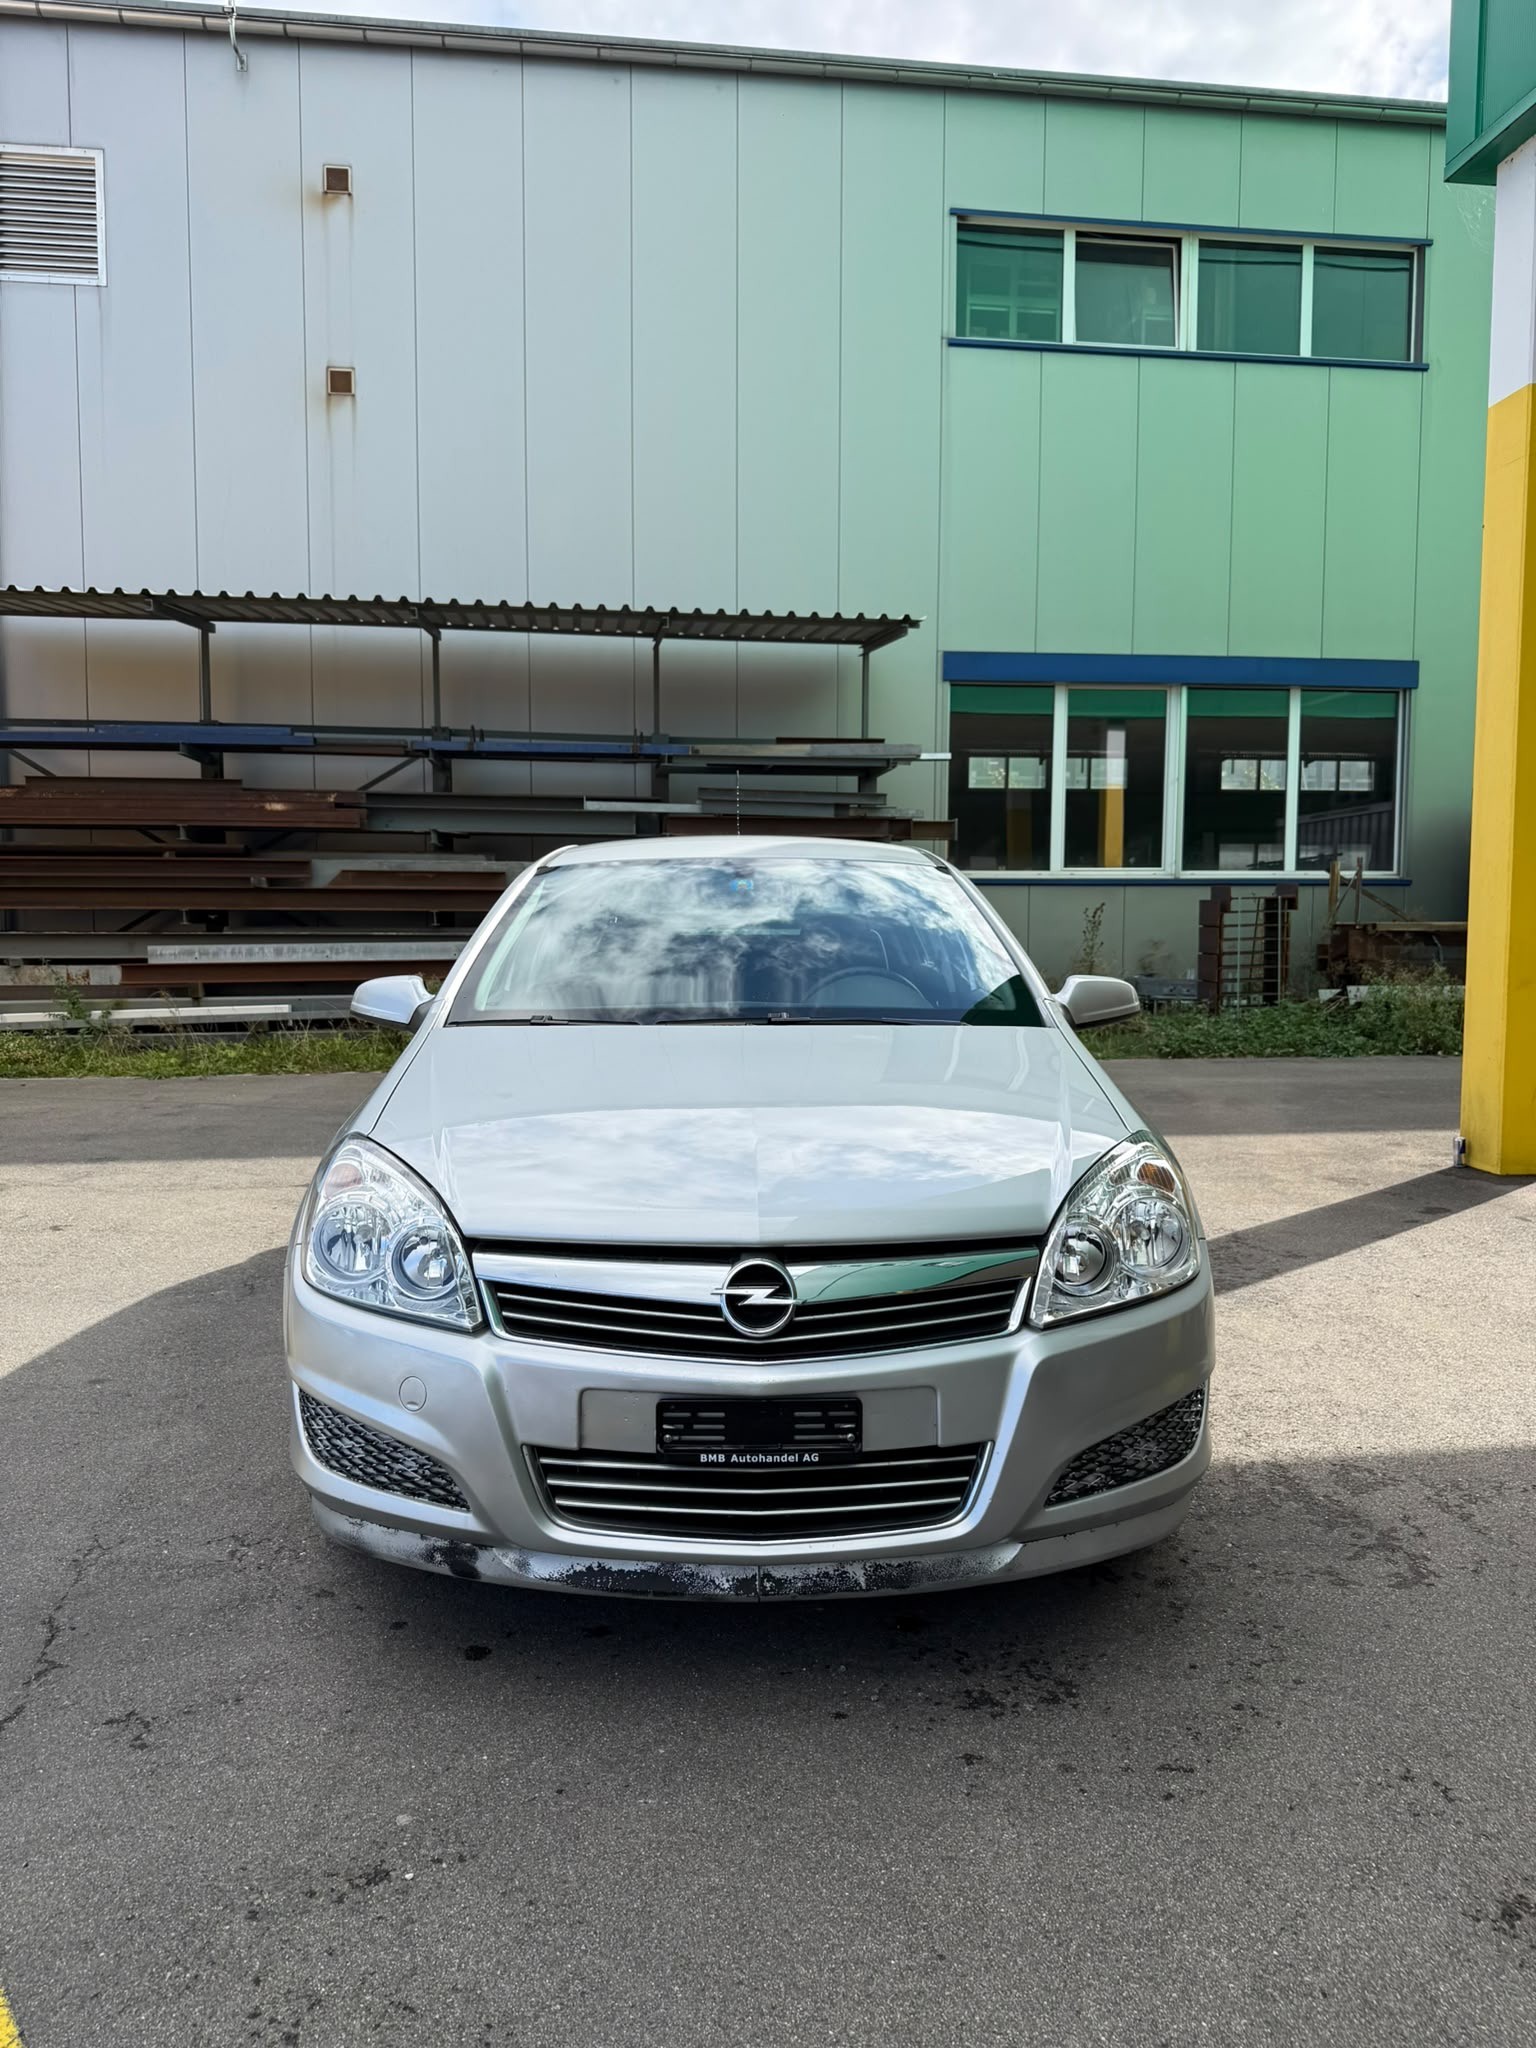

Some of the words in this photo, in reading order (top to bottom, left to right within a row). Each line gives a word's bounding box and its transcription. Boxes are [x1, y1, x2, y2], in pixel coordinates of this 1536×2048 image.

[700, 1453, 726, 1463] BMB
[730, 1453, 799, 1463] Autohandel
[802, 1453, 819, 1462] AG
